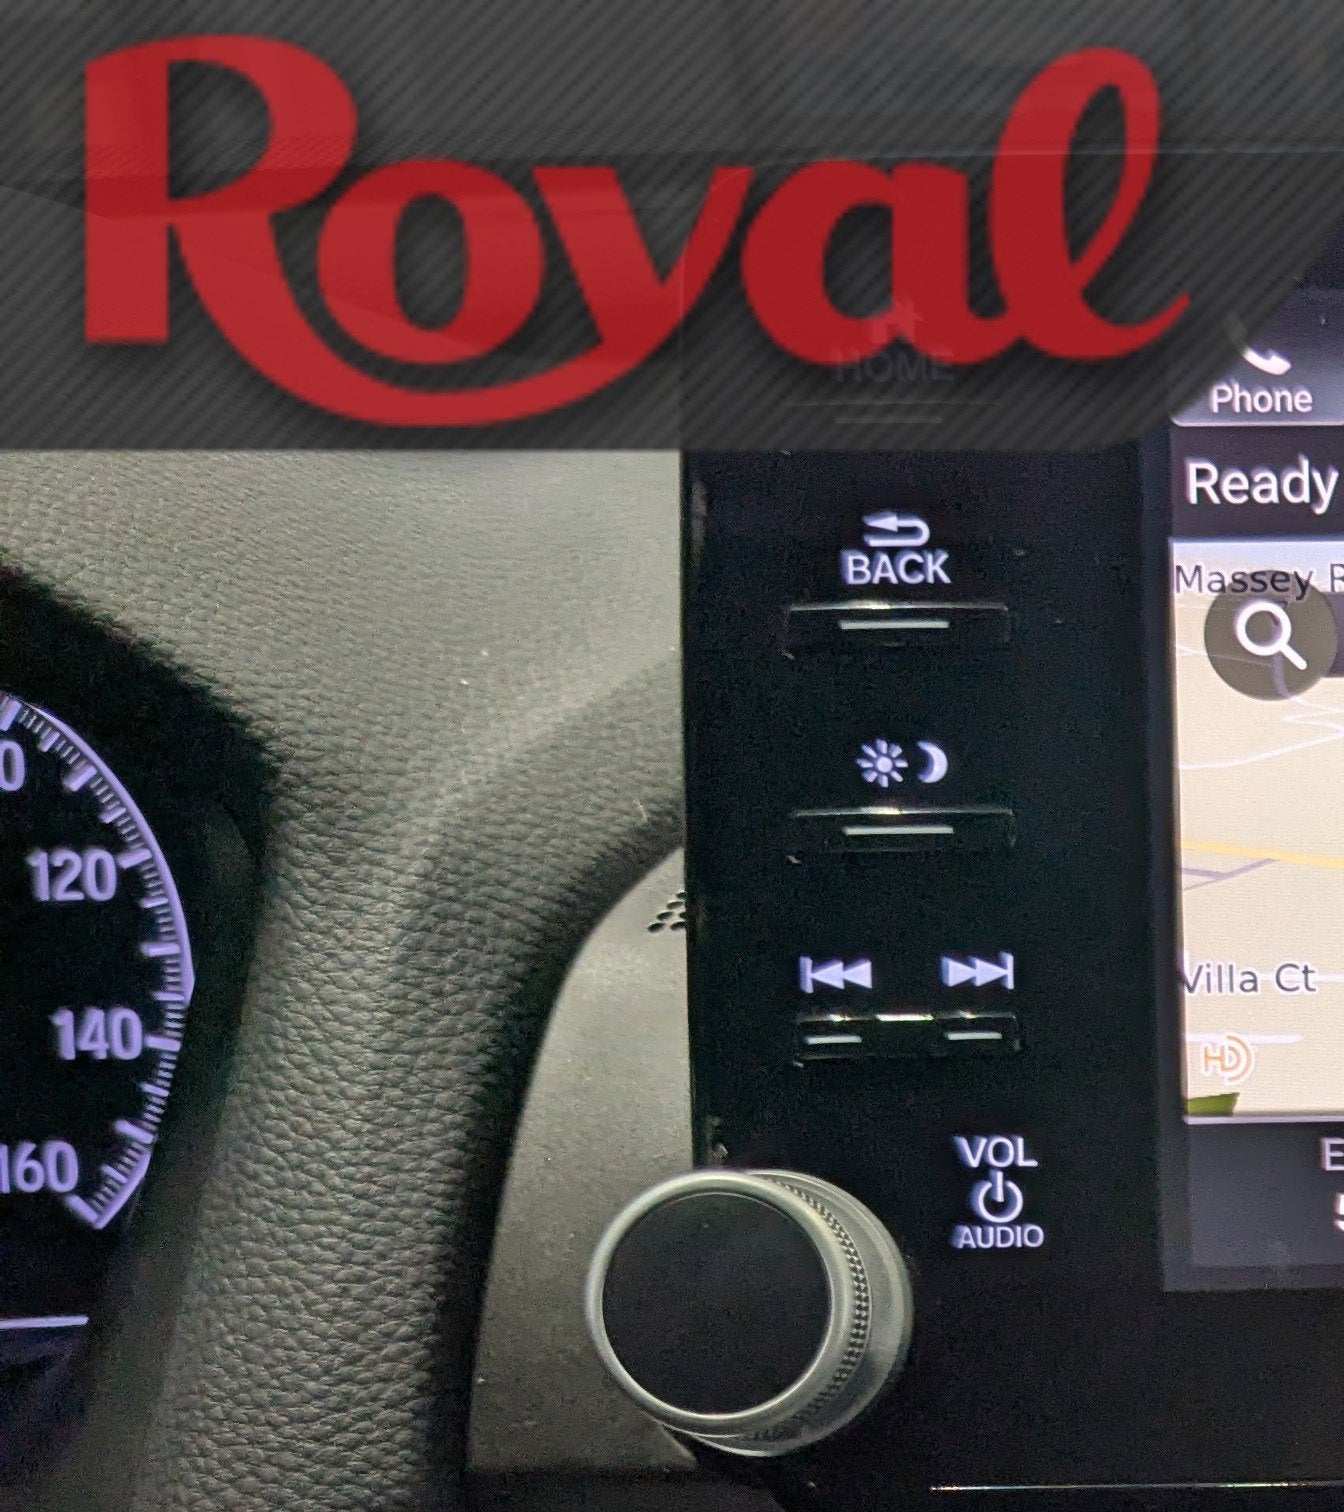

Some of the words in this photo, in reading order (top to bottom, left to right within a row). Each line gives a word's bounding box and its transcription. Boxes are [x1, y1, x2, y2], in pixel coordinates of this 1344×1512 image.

[1211, 385, 1313, 414] Phone
[1185, 459, 1337, 513] Ready
[841, 549, 951, 586] BACK
[1175, 564, 1314, 601] Massey
[27, 849, 118, 902] 120
[1184, 964, 1258, 993] Villa
[1275, 963, 1316, 992] Ct
[50, 1008, 143, 1060] 140
[0, 1140, 79, 1194] 160
[954, 1136, 1038, 1168] VOL
[953, 1224, 1045, 1250] AUDIO
